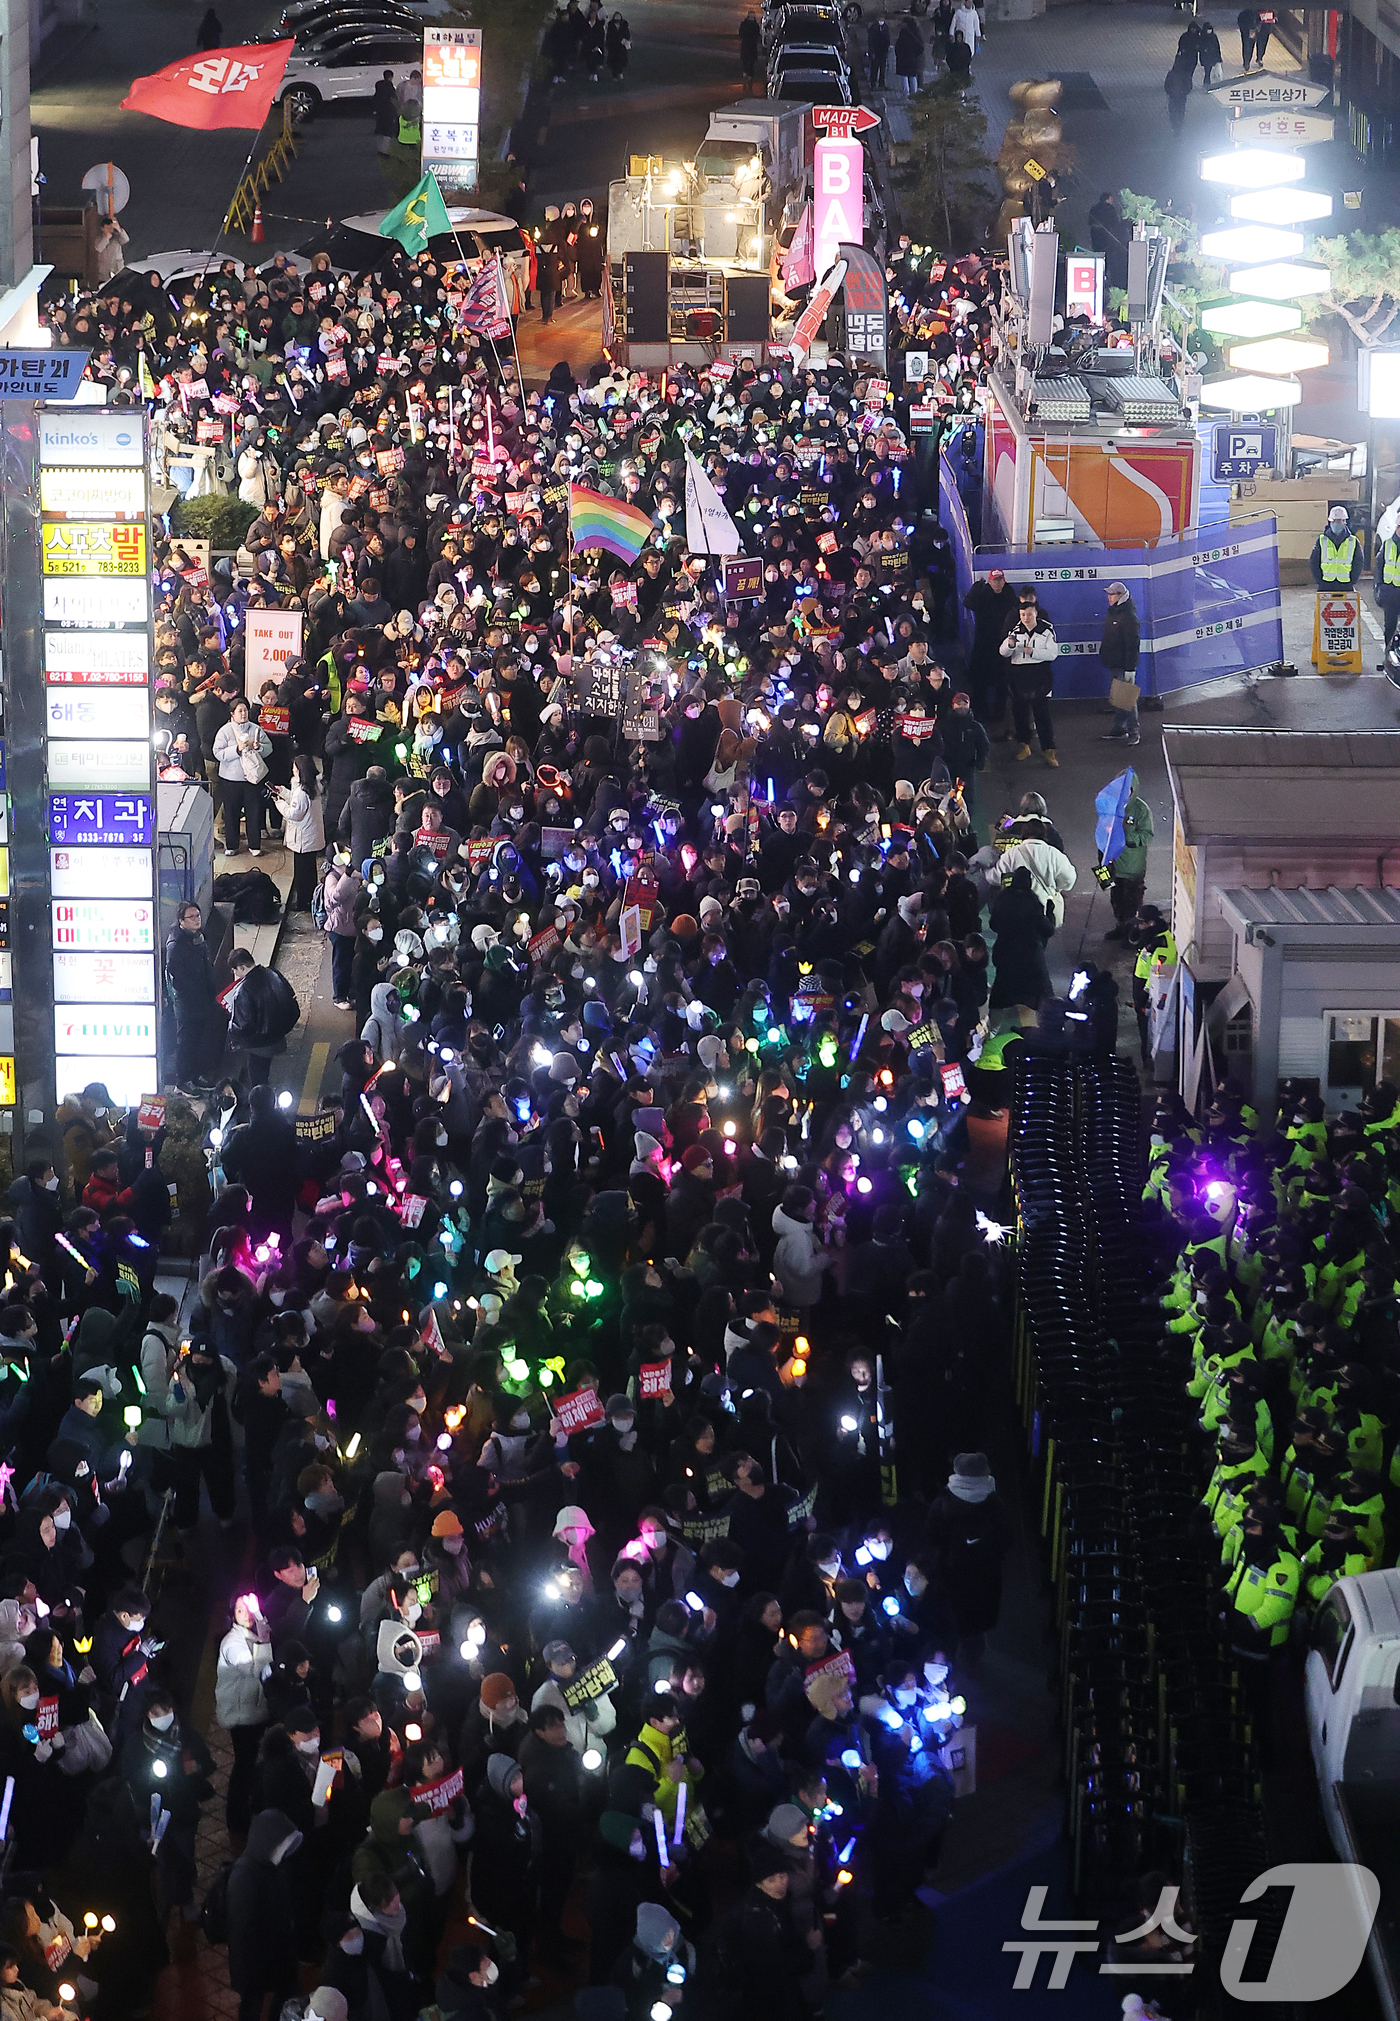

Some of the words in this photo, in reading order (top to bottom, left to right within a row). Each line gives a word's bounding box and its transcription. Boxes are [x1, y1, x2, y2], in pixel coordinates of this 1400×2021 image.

[426, 57, 478, 78] 노래방
[1229, 89, 1307, 101] 프린스텔상가
[819, 110, 858, 124] MADE
[831, 127, 844, 137] B1
[429, 164, 475, 176] SUBWAY
[45, 432, 98, 445] kinko's
[1232, 438, 1246, 456] P
[46, 527, 143, 560] 스포츠발
[1191, 552, 1210, 566] 안전
[1222, 544, 1240, 557] 제일
[98, 562, 140, 573] 783-8233
[1035, 571, 1058, 580] 안전
[1074, 569, 1098, 579] 제일
[254, 629, 273, 638] TAKE
[278, 631, 294, 639] OUT
[1195, 627, 1214, 639] 안전
[1225, 618, 1243, 630] 제일
[1074, 643, 1097, 653] 제일
[1327, 639, 1352, 650] 접근금지
[73, 799, 148, 829] 치과
[77, 833, 124, 843] 6333-7676
[132, 833, 144, 843] 3F
[93, 959, 117, 985] 꽃
